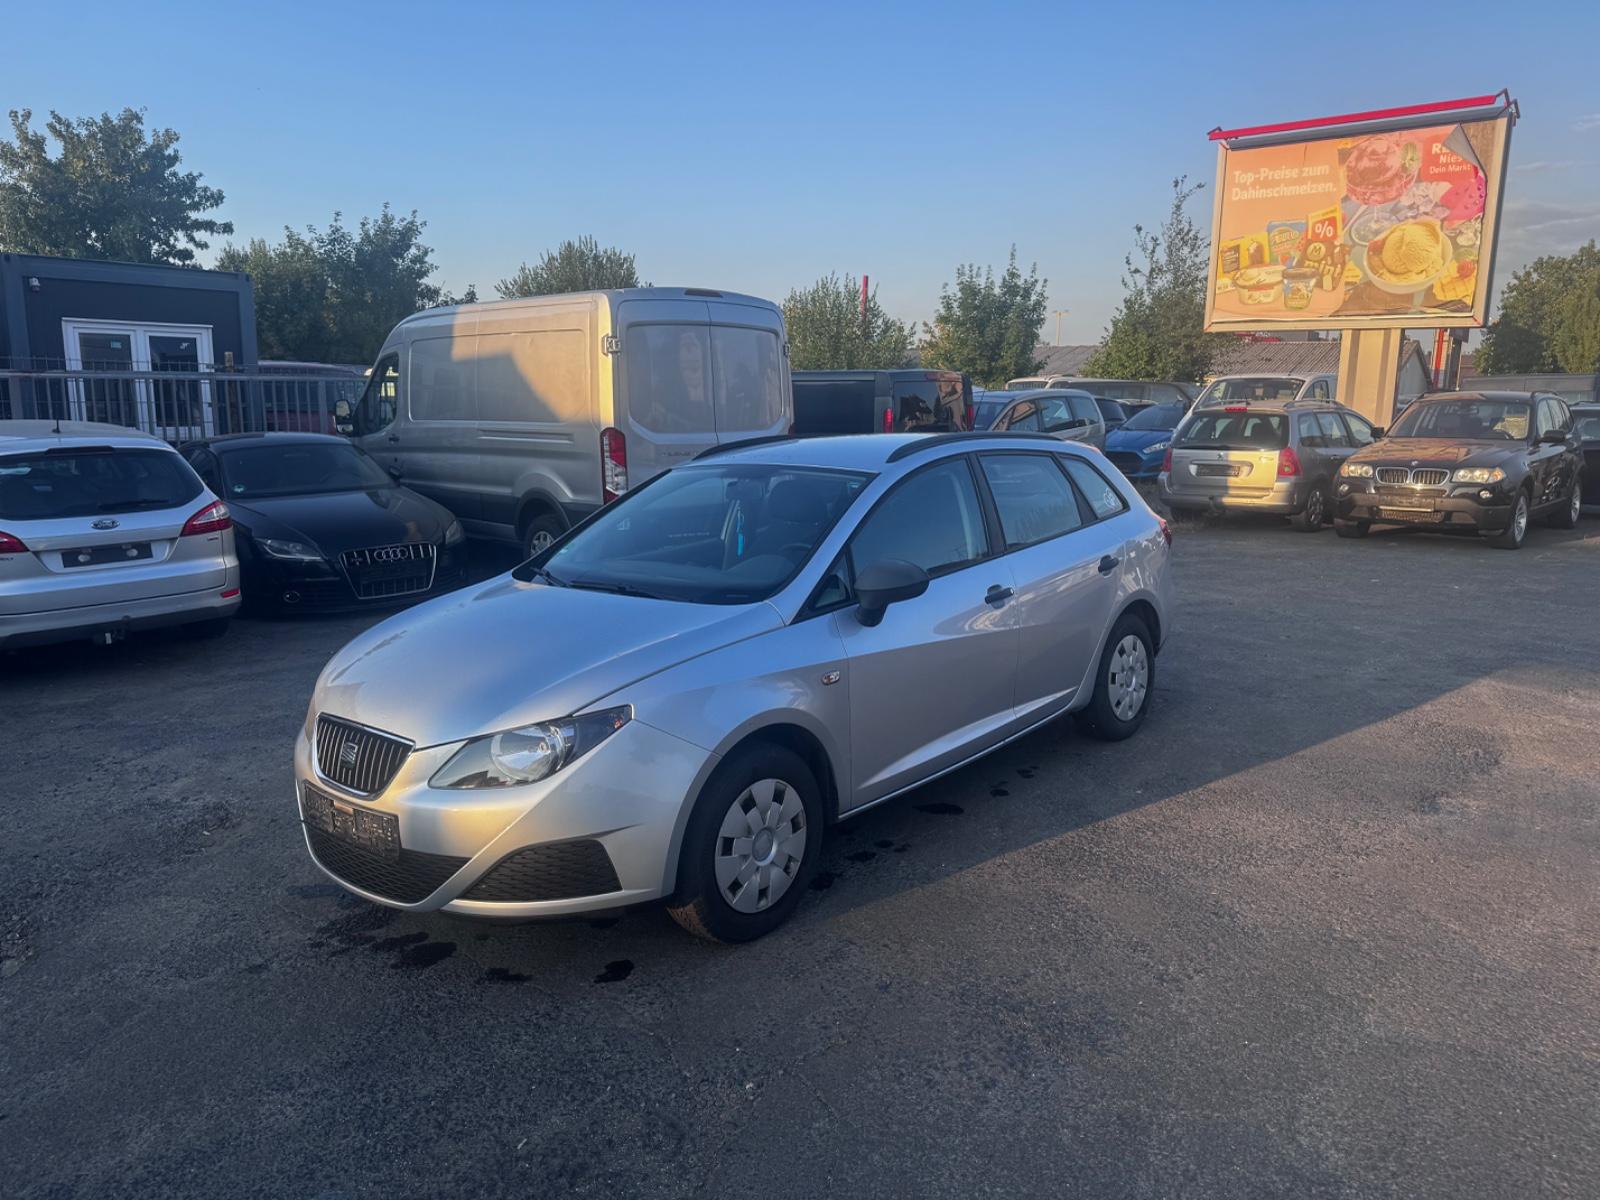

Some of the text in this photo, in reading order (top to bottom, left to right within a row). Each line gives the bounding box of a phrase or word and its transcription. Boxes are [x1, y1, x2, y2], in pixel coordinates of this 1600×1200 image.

[1233, 164, 1330, 185] Top-Preise zum
[1429, 164, 1446, 174] Dein
[1232, 180, 1337, 201] Dahinschmelzen.
[1315, 221, 1333, 239] %
